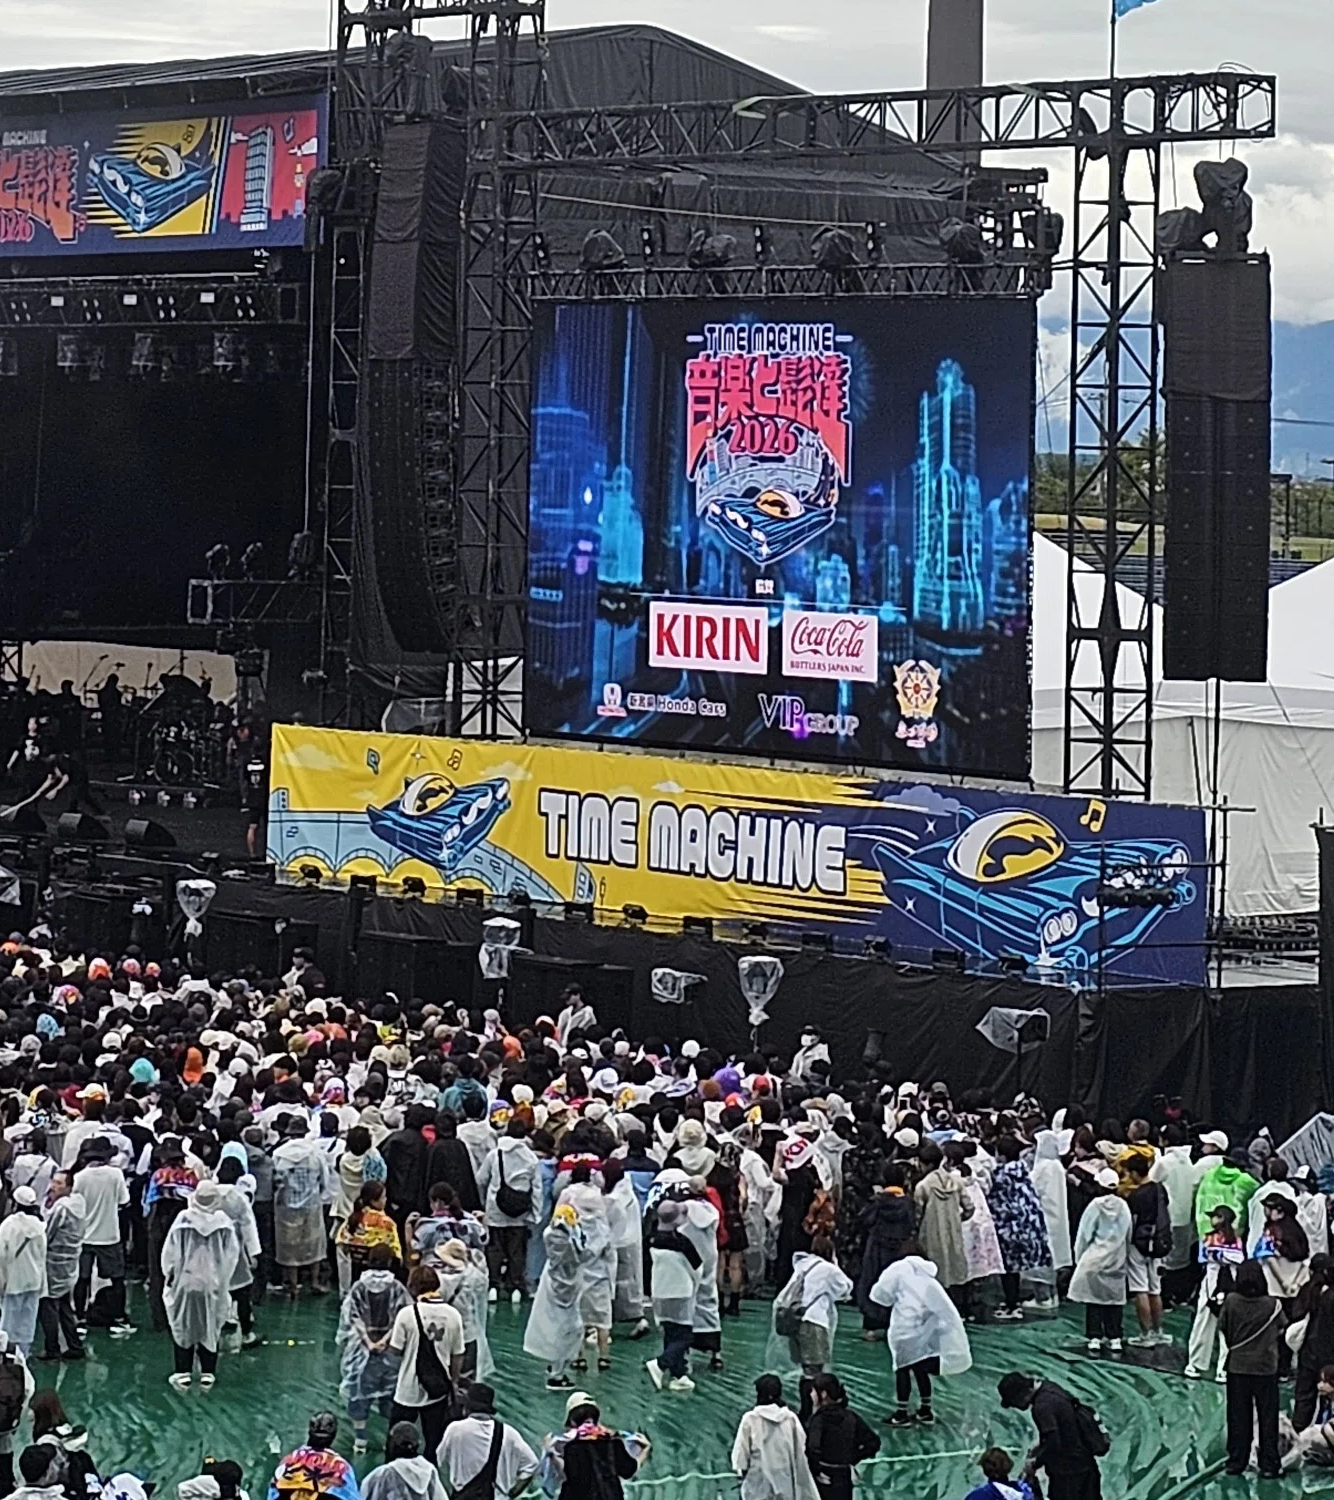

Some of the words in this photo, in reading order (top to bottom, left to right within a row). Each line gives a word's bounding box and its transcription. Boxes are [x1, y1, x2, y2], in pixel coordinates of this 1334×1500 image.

[2, 129, 48, 147] MACHINE
[704, 323, 748, 352] TIME
[751, 323, 835, 352] MACHINE
[729, 418, 799, 455] 2026
[655, 611, 761, 663] KIRIN
[790, 660, 827, 671] BOTTLERS
[828, 663, 850, 673] JAPAN
[657, 694, 697, 714] Honda
[698, 697, 727, 717] Cars
[757, 693, 805, 731] VIP
[803, 712, 860, 736] GROUP
[539, 788, 640, 868] TIME
[647, 801, 847, 895] MACHINE
